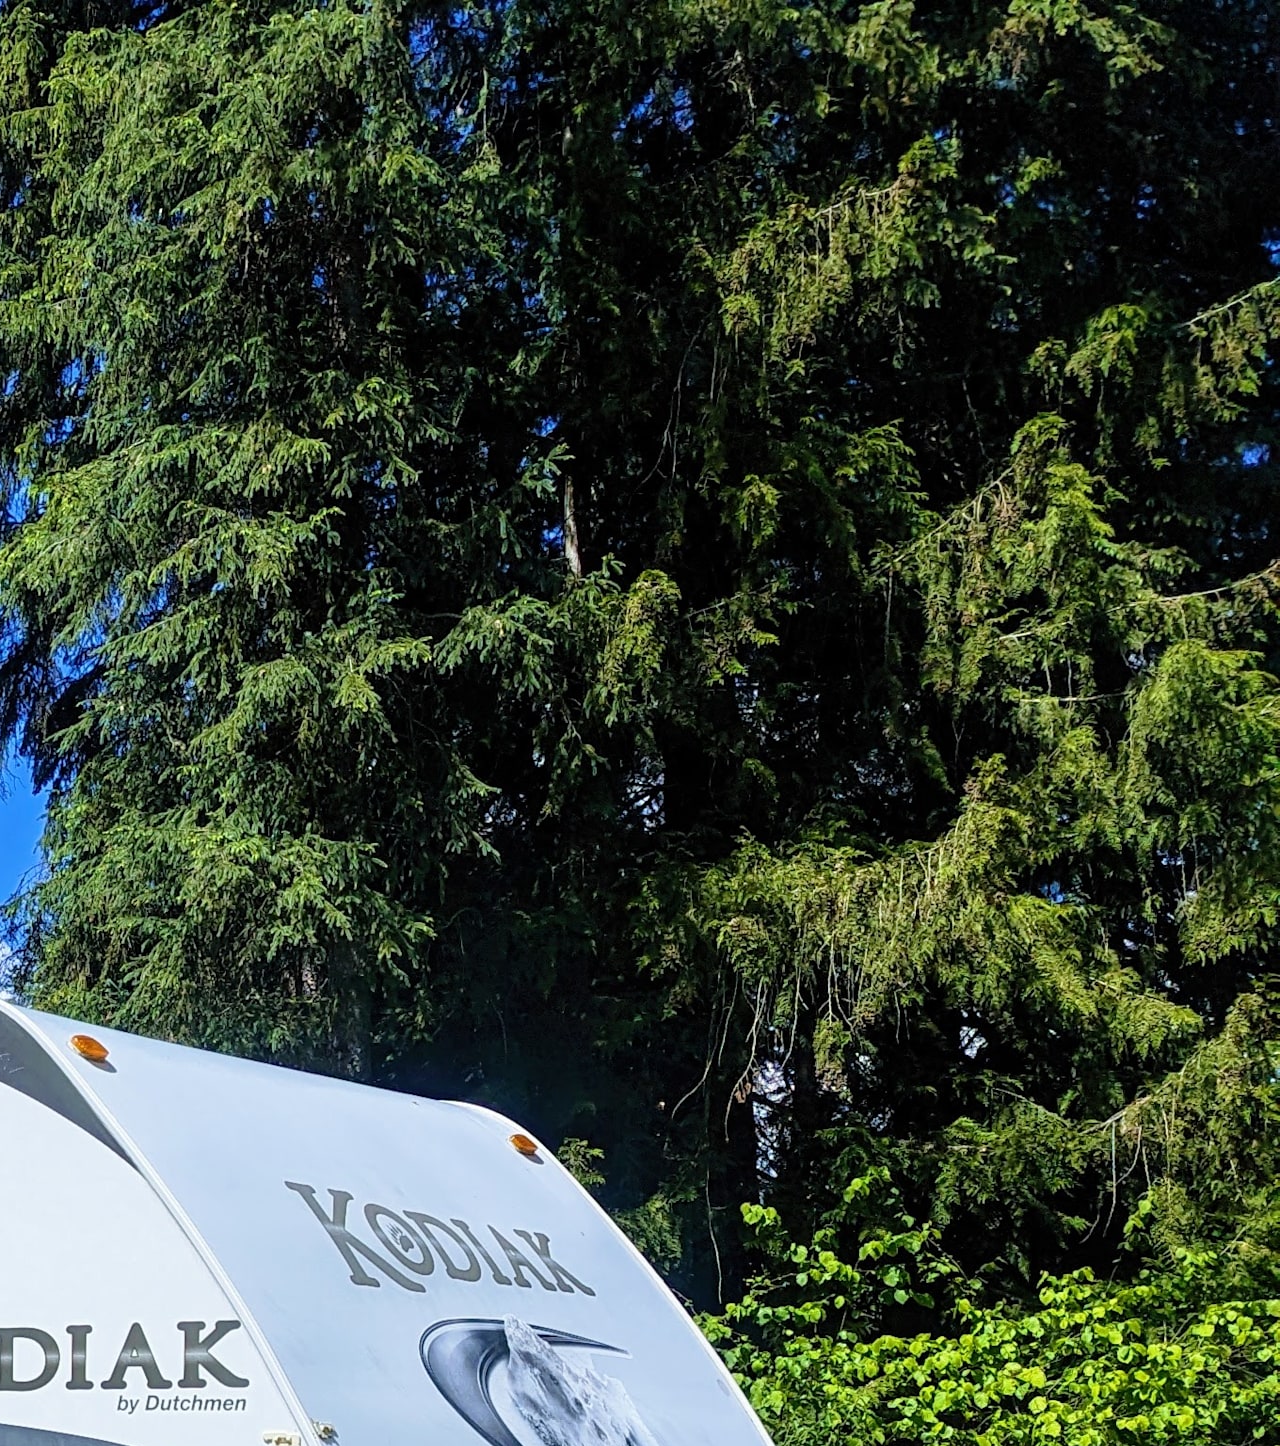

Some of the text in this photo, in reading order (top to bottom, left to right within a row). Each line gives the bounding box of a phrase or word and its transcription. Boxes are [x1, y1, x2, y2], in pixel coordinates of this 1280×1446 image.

[285, 1180, 596, 1297] KODIAK
[117, 1394, 247, 1414] by Dutchmen
